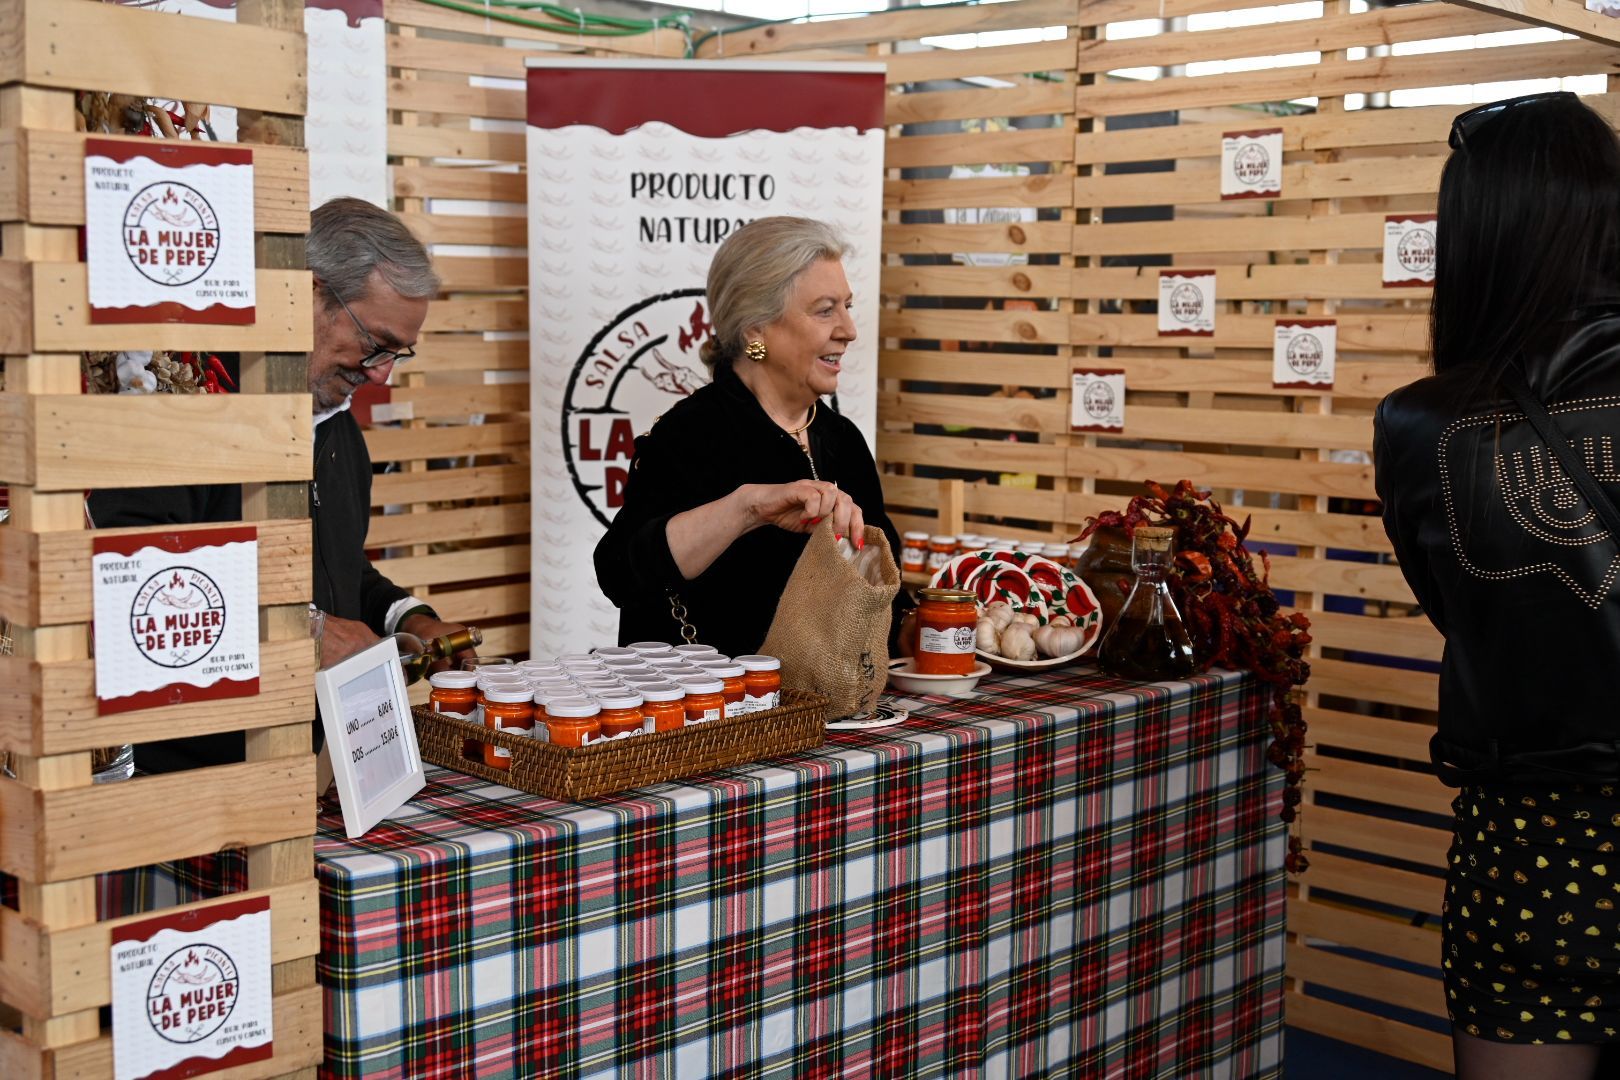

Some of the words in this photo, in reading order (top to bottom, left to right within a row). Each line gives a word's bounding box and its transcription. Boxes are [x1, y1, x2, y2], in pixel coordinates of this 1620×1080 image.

[630, 172, 776, 200] PRODUCTO
[129, 229, 150, 246] LA
[158, 230, 215, 248] MUJER
[138, 248, 158, 265] DE
[165, 249, 206, 267] PEPE
[585, 321, 651, 390] SALSA
[579, 418, 636, 461] LA
[190, 573, 220, 604] PICANTE
[136, 617, 157, 634] LA
[165, 611, 221, 631] MUJER
[145, 634, 166, 651] DE
[172, 629, 212, 648] PEPE
[346, 718, 359, 735] UNO
[352, 746, 364, 763] DOS
[204, 949, 234, 977] PICANTE
[152, 997, 172, 1016] LA
[180, 983, 234, 1009] MUJER
[161, 1012, 181, 1031] DE
[187, 1001, 226, 1024] PEPE
